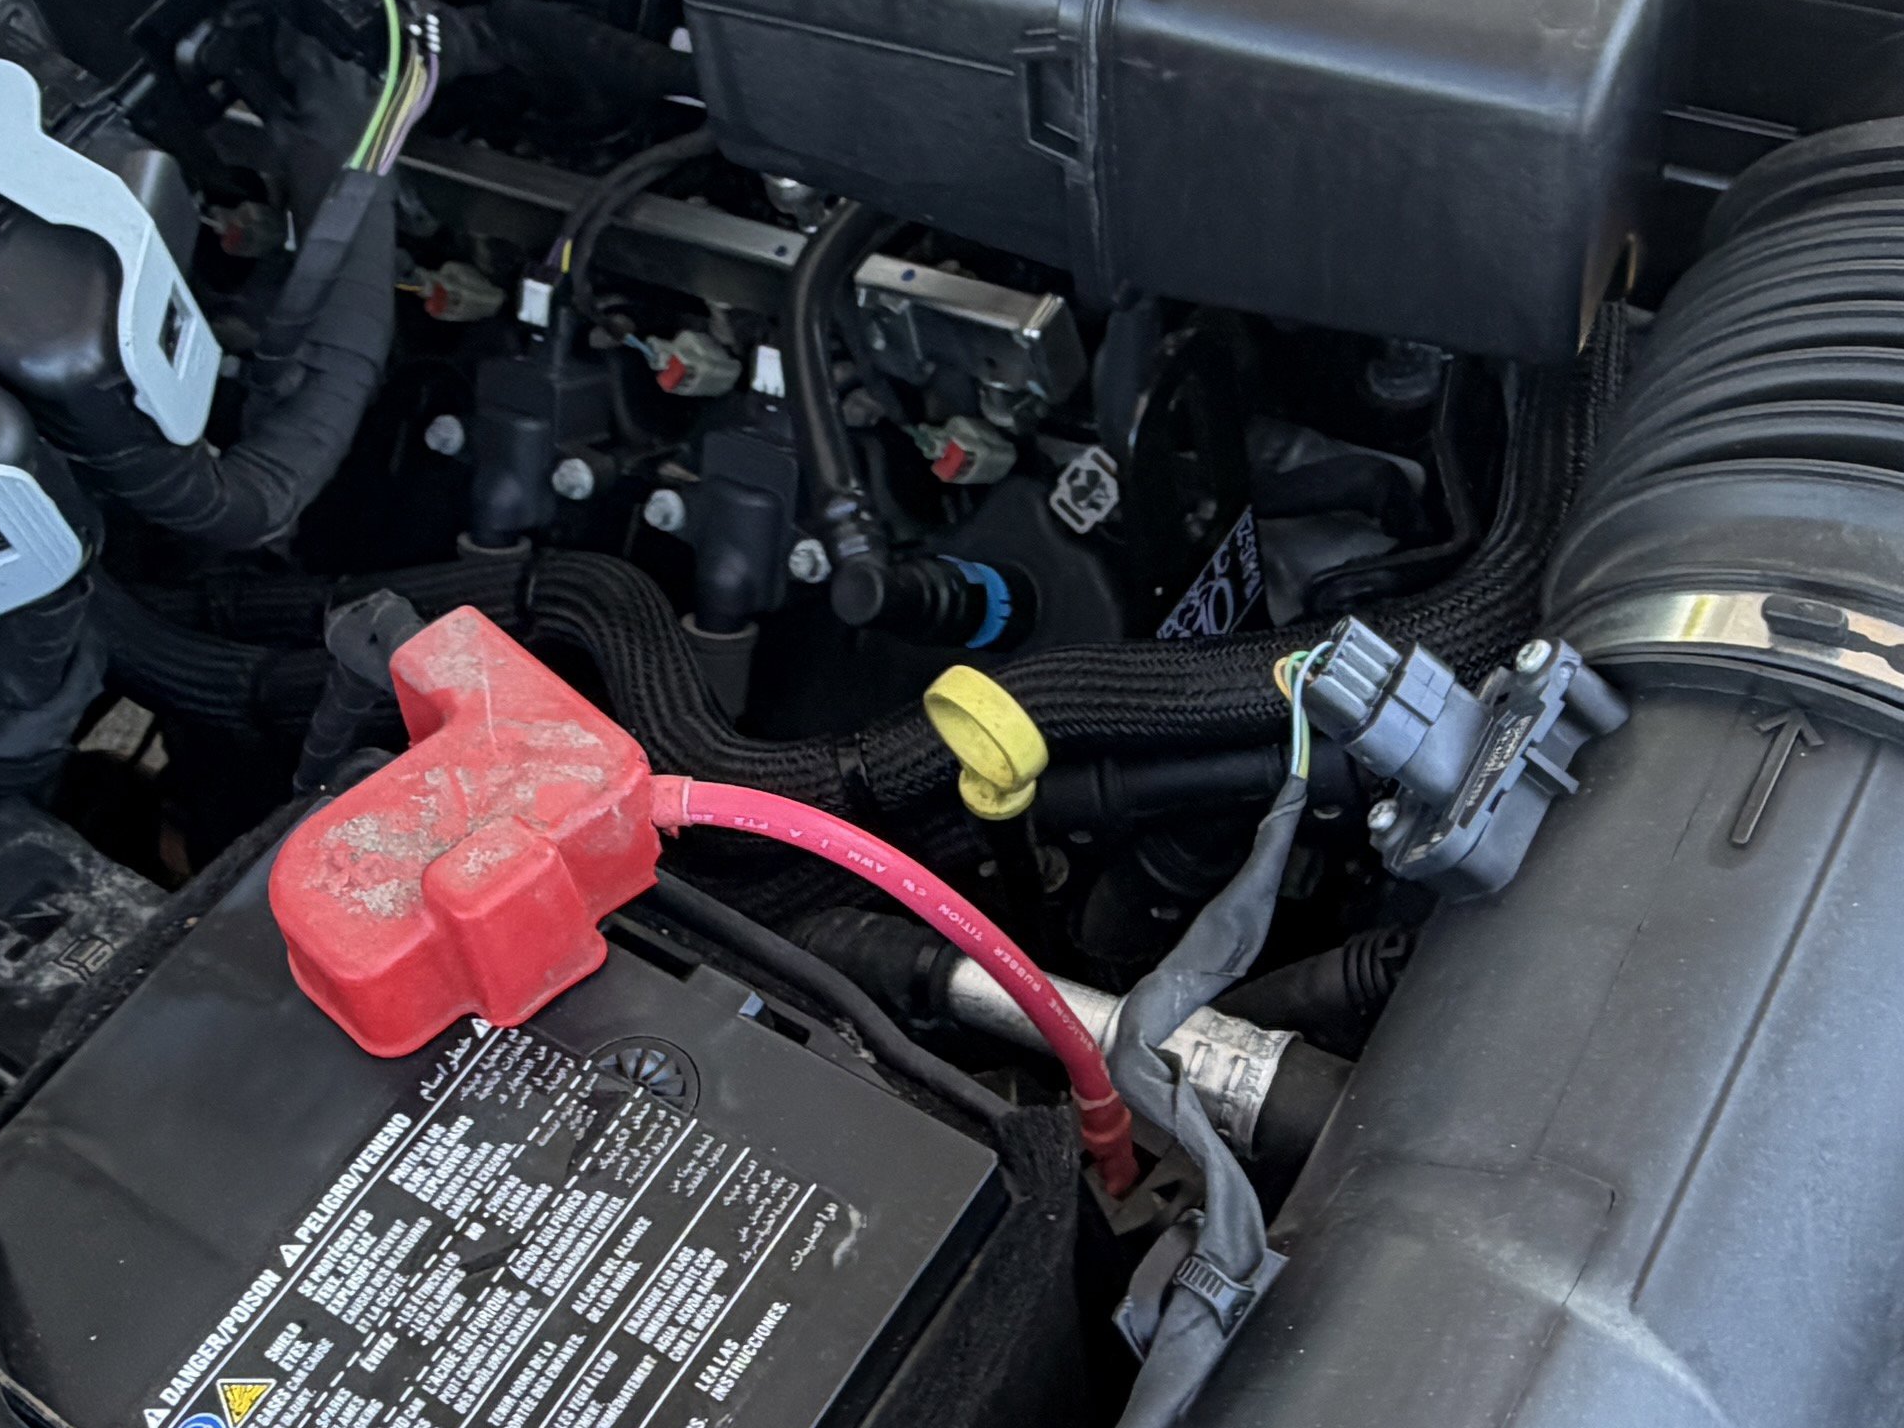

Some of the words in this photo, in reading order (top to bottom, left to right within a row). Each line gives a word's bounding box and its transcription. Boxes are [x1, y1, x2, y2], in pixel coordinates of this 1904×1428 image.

[846, 841, 887, 873] AWM
[992, 945, 1041, 992] RUBBER
[295, 1113, 410, 1243] PELIGRO/VENENO
[349, 1209, 373, 1232] LES
[497, 1183, 532, 1221] FLAMAS
[336, 1252, 360, 1274] LES
[508, 1243, 543, 1279] ÁCIDO
[396, 1302, 418, 1323] LES
[409, 1311, 431, 1332] LES
[452, 1286, 511, 1353] SULFURIQUE
[159, 1269, 280, 1405] DANGER/POISON
[538, 1340, 557, 1356] LA
[710, 1302, 790, 1401] INSTRUCCIONES.
[694, 1364, 722, 1391] LEA
[712, 1338, 739, 1366] LAS
[255, 1387, 291, 1426] GASES
